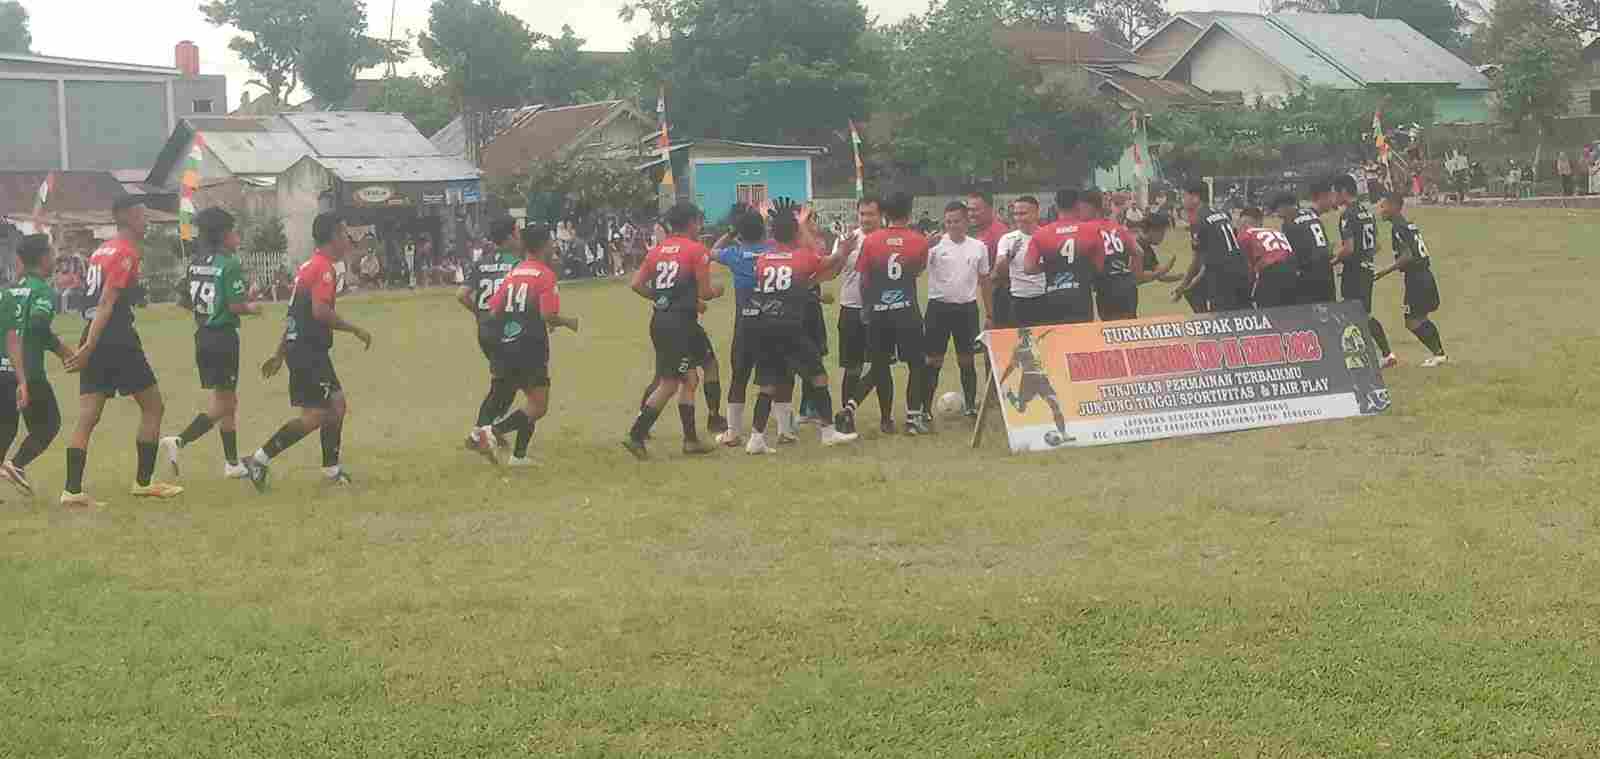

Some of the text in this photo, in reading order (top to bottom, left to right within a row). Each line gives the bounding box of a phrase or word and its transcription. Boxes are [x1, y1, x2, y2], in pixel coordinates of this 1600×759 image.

[1060, 239, 1075, 264] 4
[1100, 229, 1124, 256] 26
[656, 261, 679, 288] 22
[763, 265, 793, 293] 28
[887, 253, 902, 280] 6
[504, 281, 528, 312] 14
[1103, 315, 1273, 342] TURNAMEN SEPAK BOLA
[1166, 373, 1234, 393] PERMAINAN
[1234, 367, 1303, 385] TERBAIKMU
[1079, 397, 1135, 416] JUNJUNG
[1136, 390, 1178, 410] TINGGI
[1180, 385, 1256, 406] SPORTIFITAS
[1271, 380, 1300, 396] FAIR
[1300, 377, 1329, 393] PLAY
